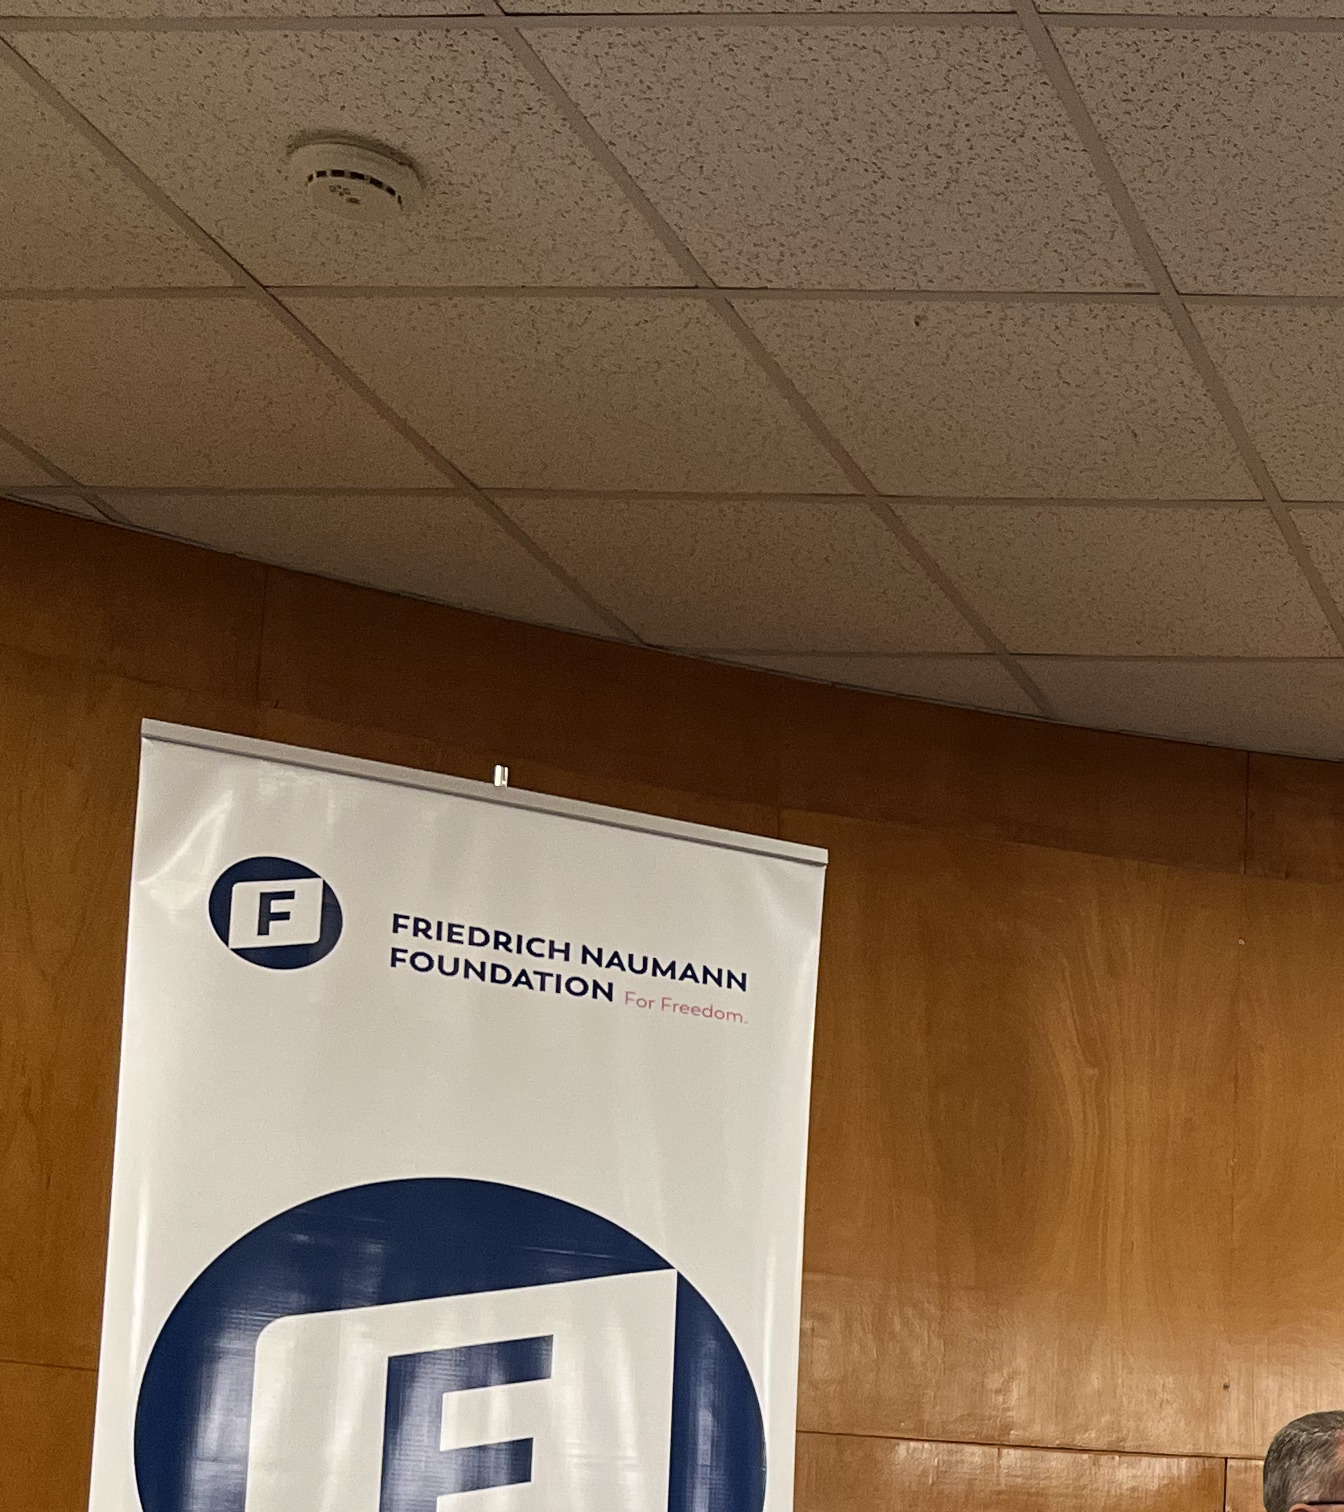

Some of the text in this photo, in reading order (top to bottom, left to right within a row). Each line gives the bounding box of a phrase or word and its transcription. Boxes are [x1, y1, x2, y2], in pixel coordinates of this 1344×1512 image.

[257, 892, 296, 936] F
[392, 913, 747, 992] FRIEDRICH NAUMANN
[390, 947, 749, 1024] FOUNDATION For Freedom.
